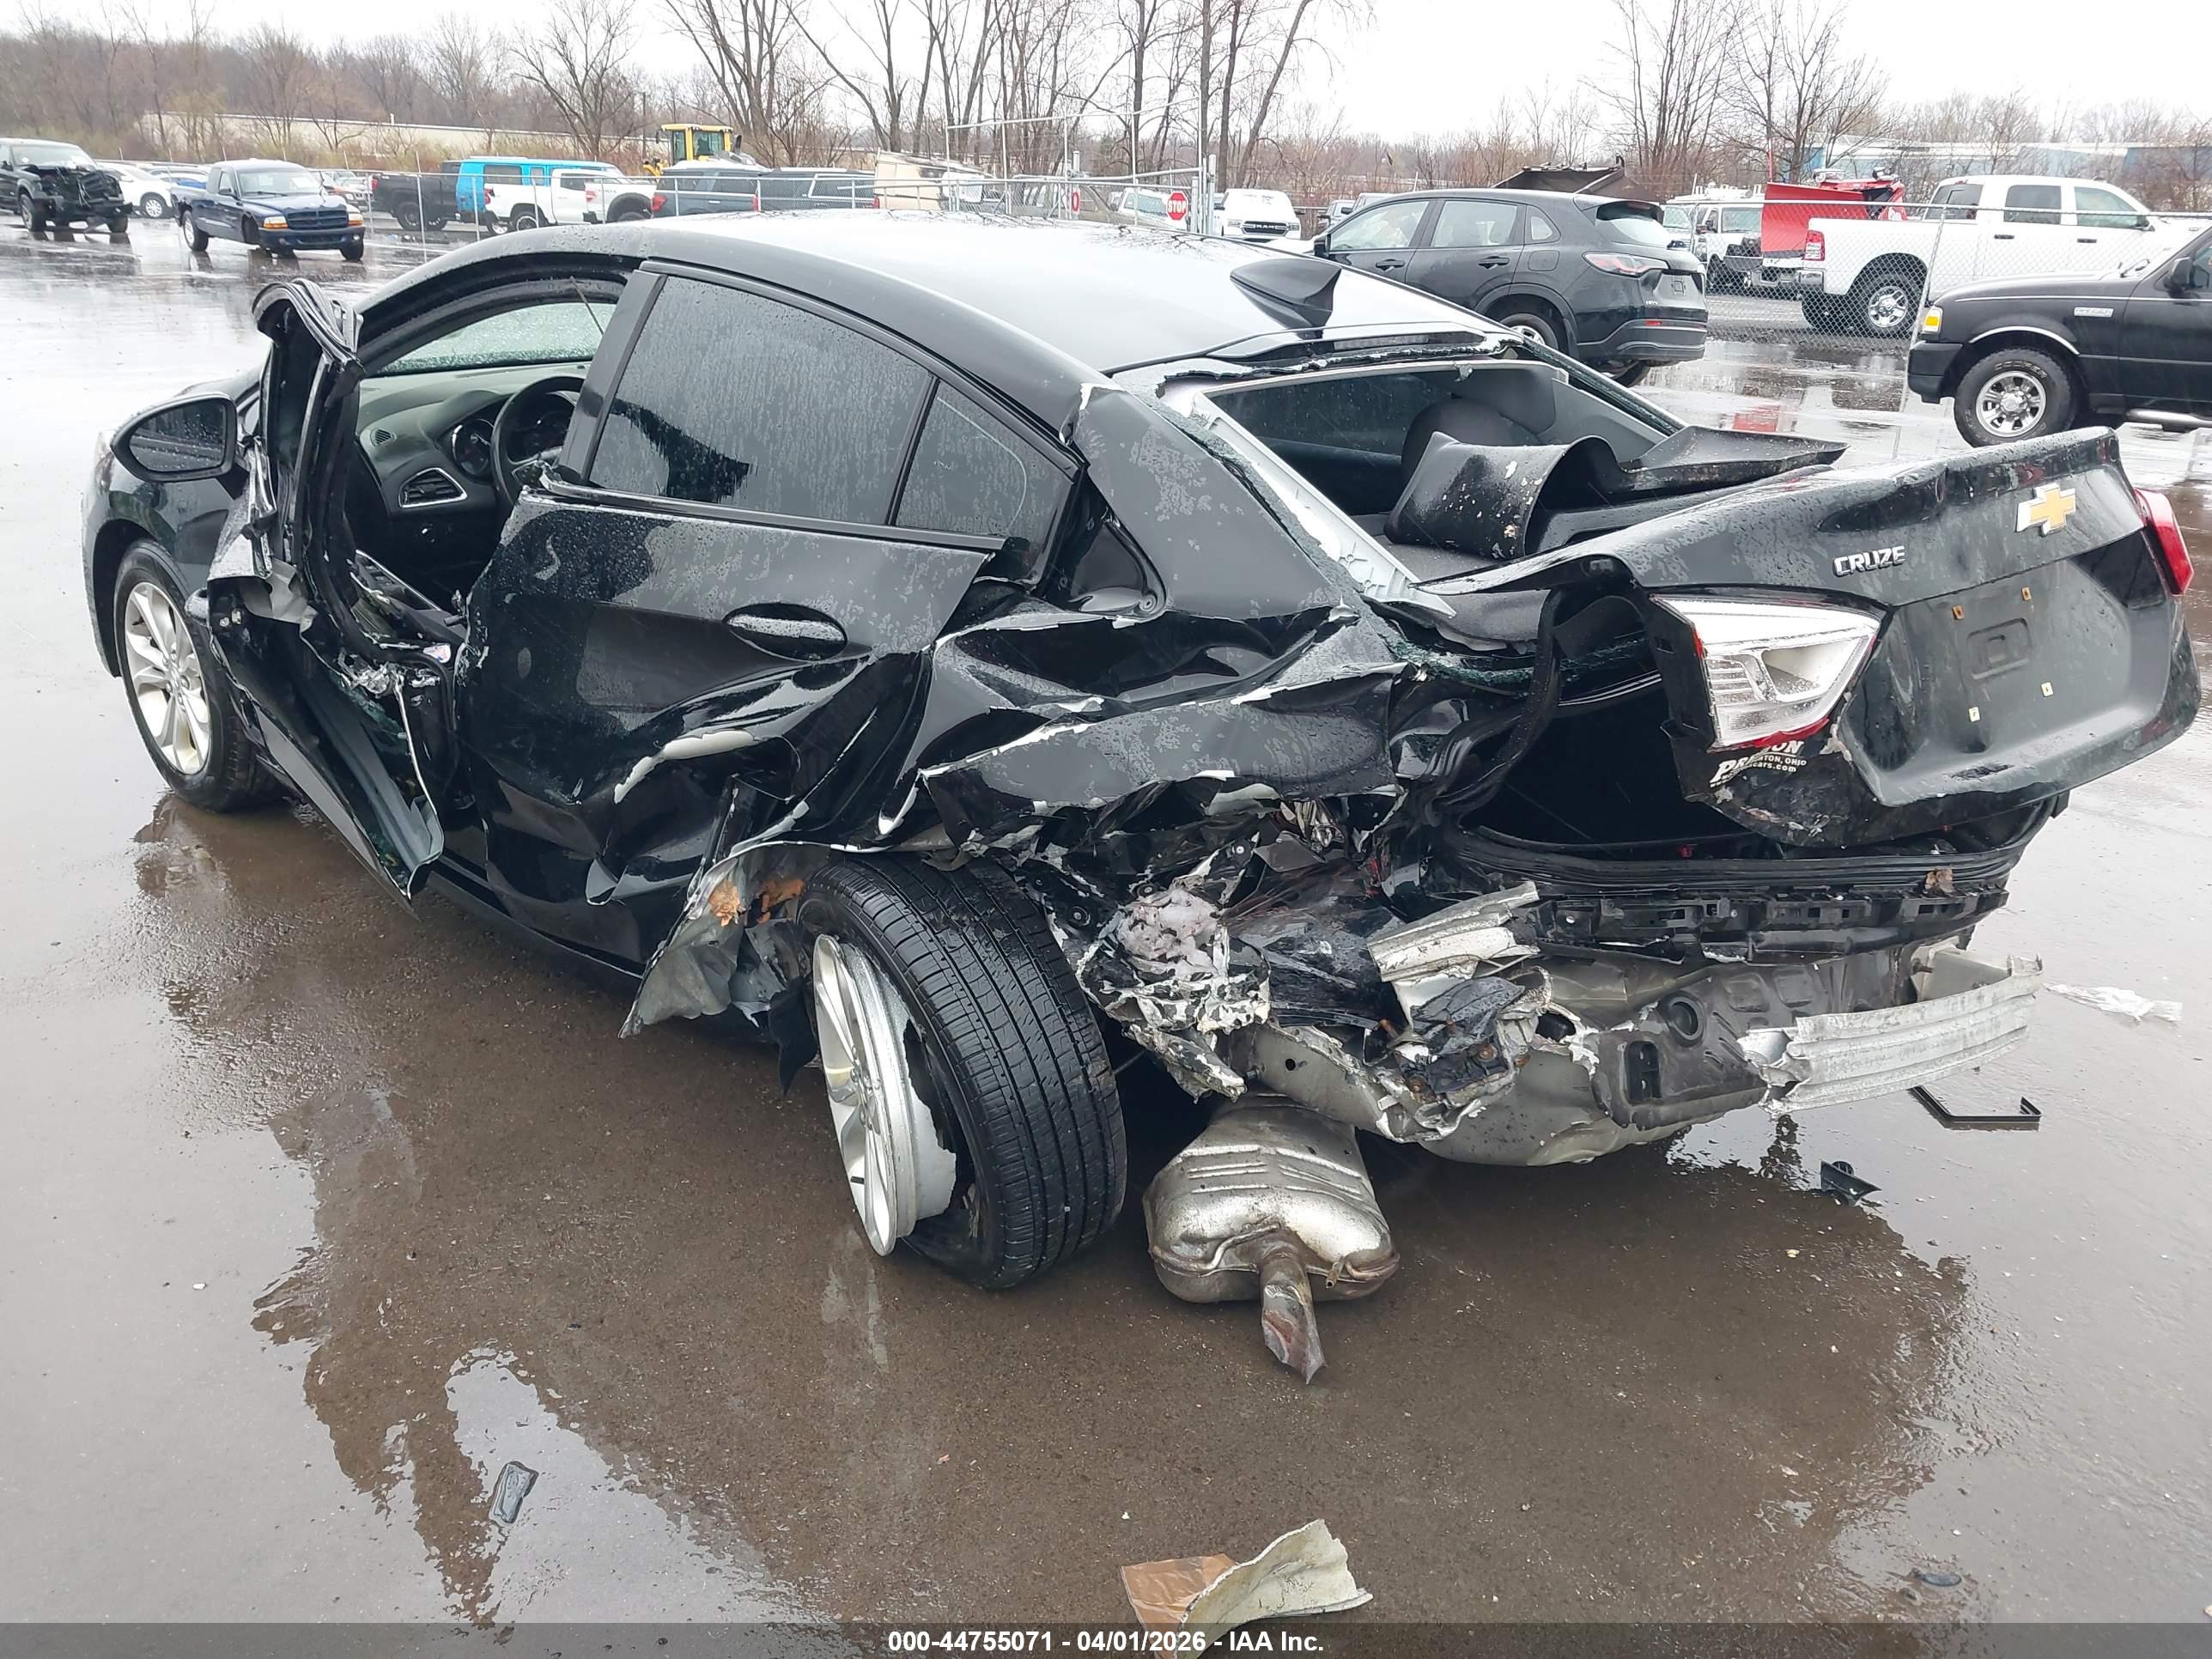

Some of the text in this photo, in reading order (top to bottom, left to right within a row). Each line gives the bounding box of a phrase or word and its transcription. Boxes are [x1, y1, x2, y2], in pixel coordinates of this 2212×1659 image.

[1168, 199, 1187, 214] STOP
[1833, 545, 1906, 577] CRUZE
[1784, 757, 1807, 766] OHIO
